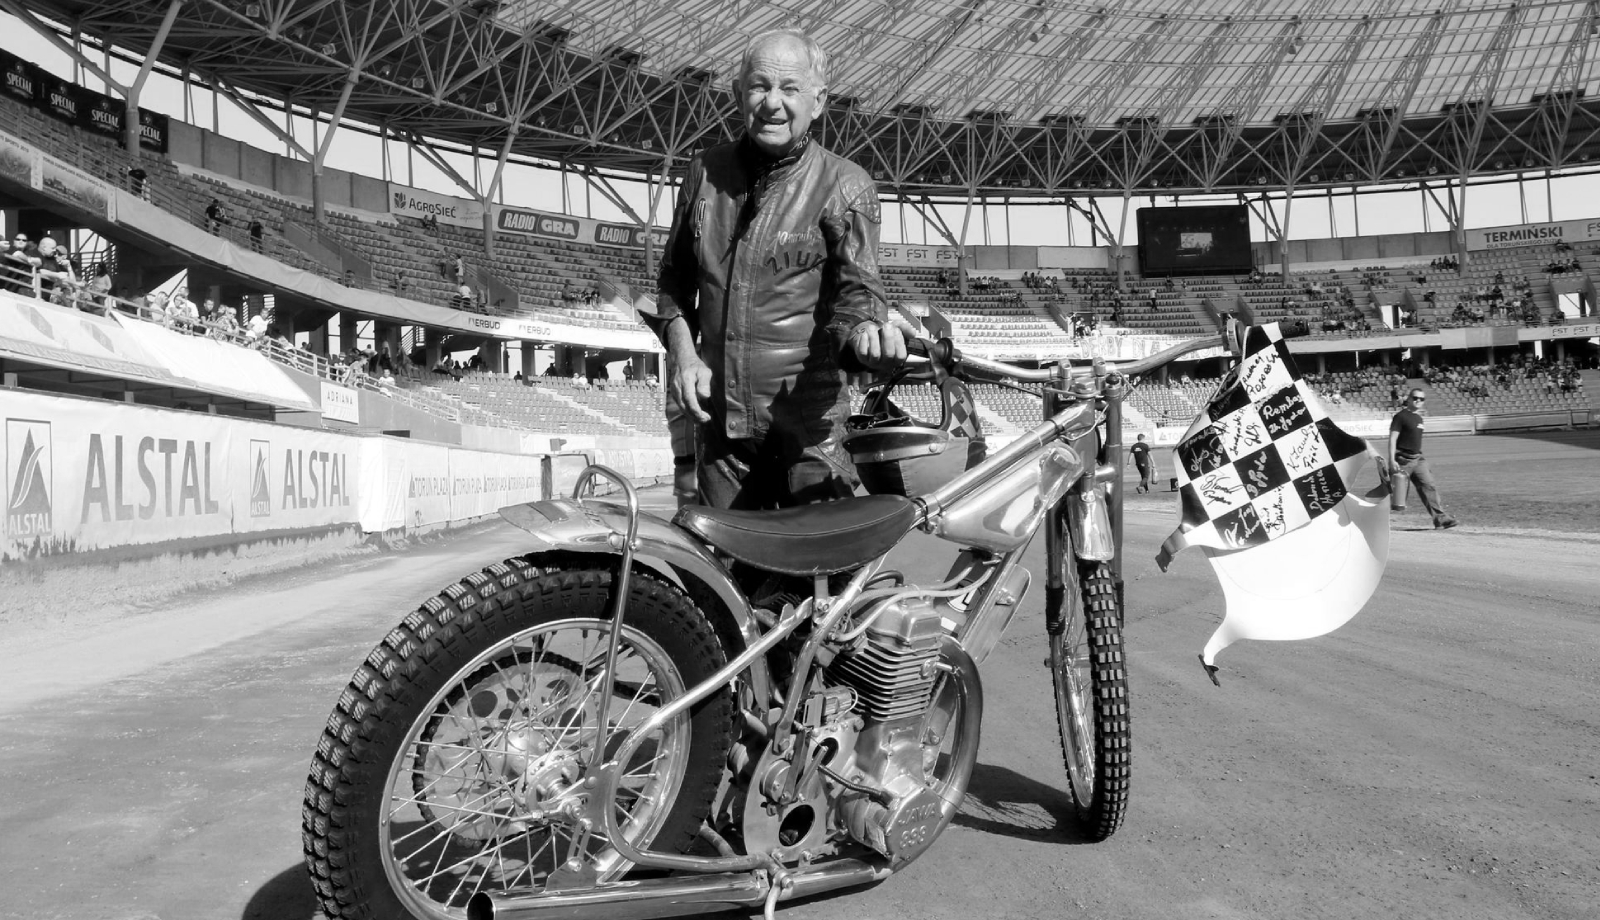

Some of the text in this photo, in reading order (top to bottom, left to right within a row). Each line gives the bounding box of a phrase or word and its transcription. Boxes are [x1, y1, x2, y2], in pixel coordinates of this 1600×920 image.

[6, 72, 34, 95] SPECIAL
[50, 93, 77, 114] SPECIAL
[91, 109, 120, 128] SPECIAL
[138, 124, 161, 142] PECIAL
[503, 212, 536, 231] RADIO
[541, 219, 576, 236] GRA
[1483, 225, 1563, 243] TERMIŃSKI
[599, 226, 630, 244] RADIO
[906, 248, 928, 259] FST
[936, 250, 958, 260] FST
[1080, 335, 1123, 358] DERBY
[327, 390, 353, 405] ADRIANA
[80, 433, 219, 525] ALSTAL
[282, 448, 350, 511] ALSTAL
[251, 501, 270, 515] ALSTAL
[9, 513, 51, 535] ALSTAL
[898, 802, 937, 825] JAWA
